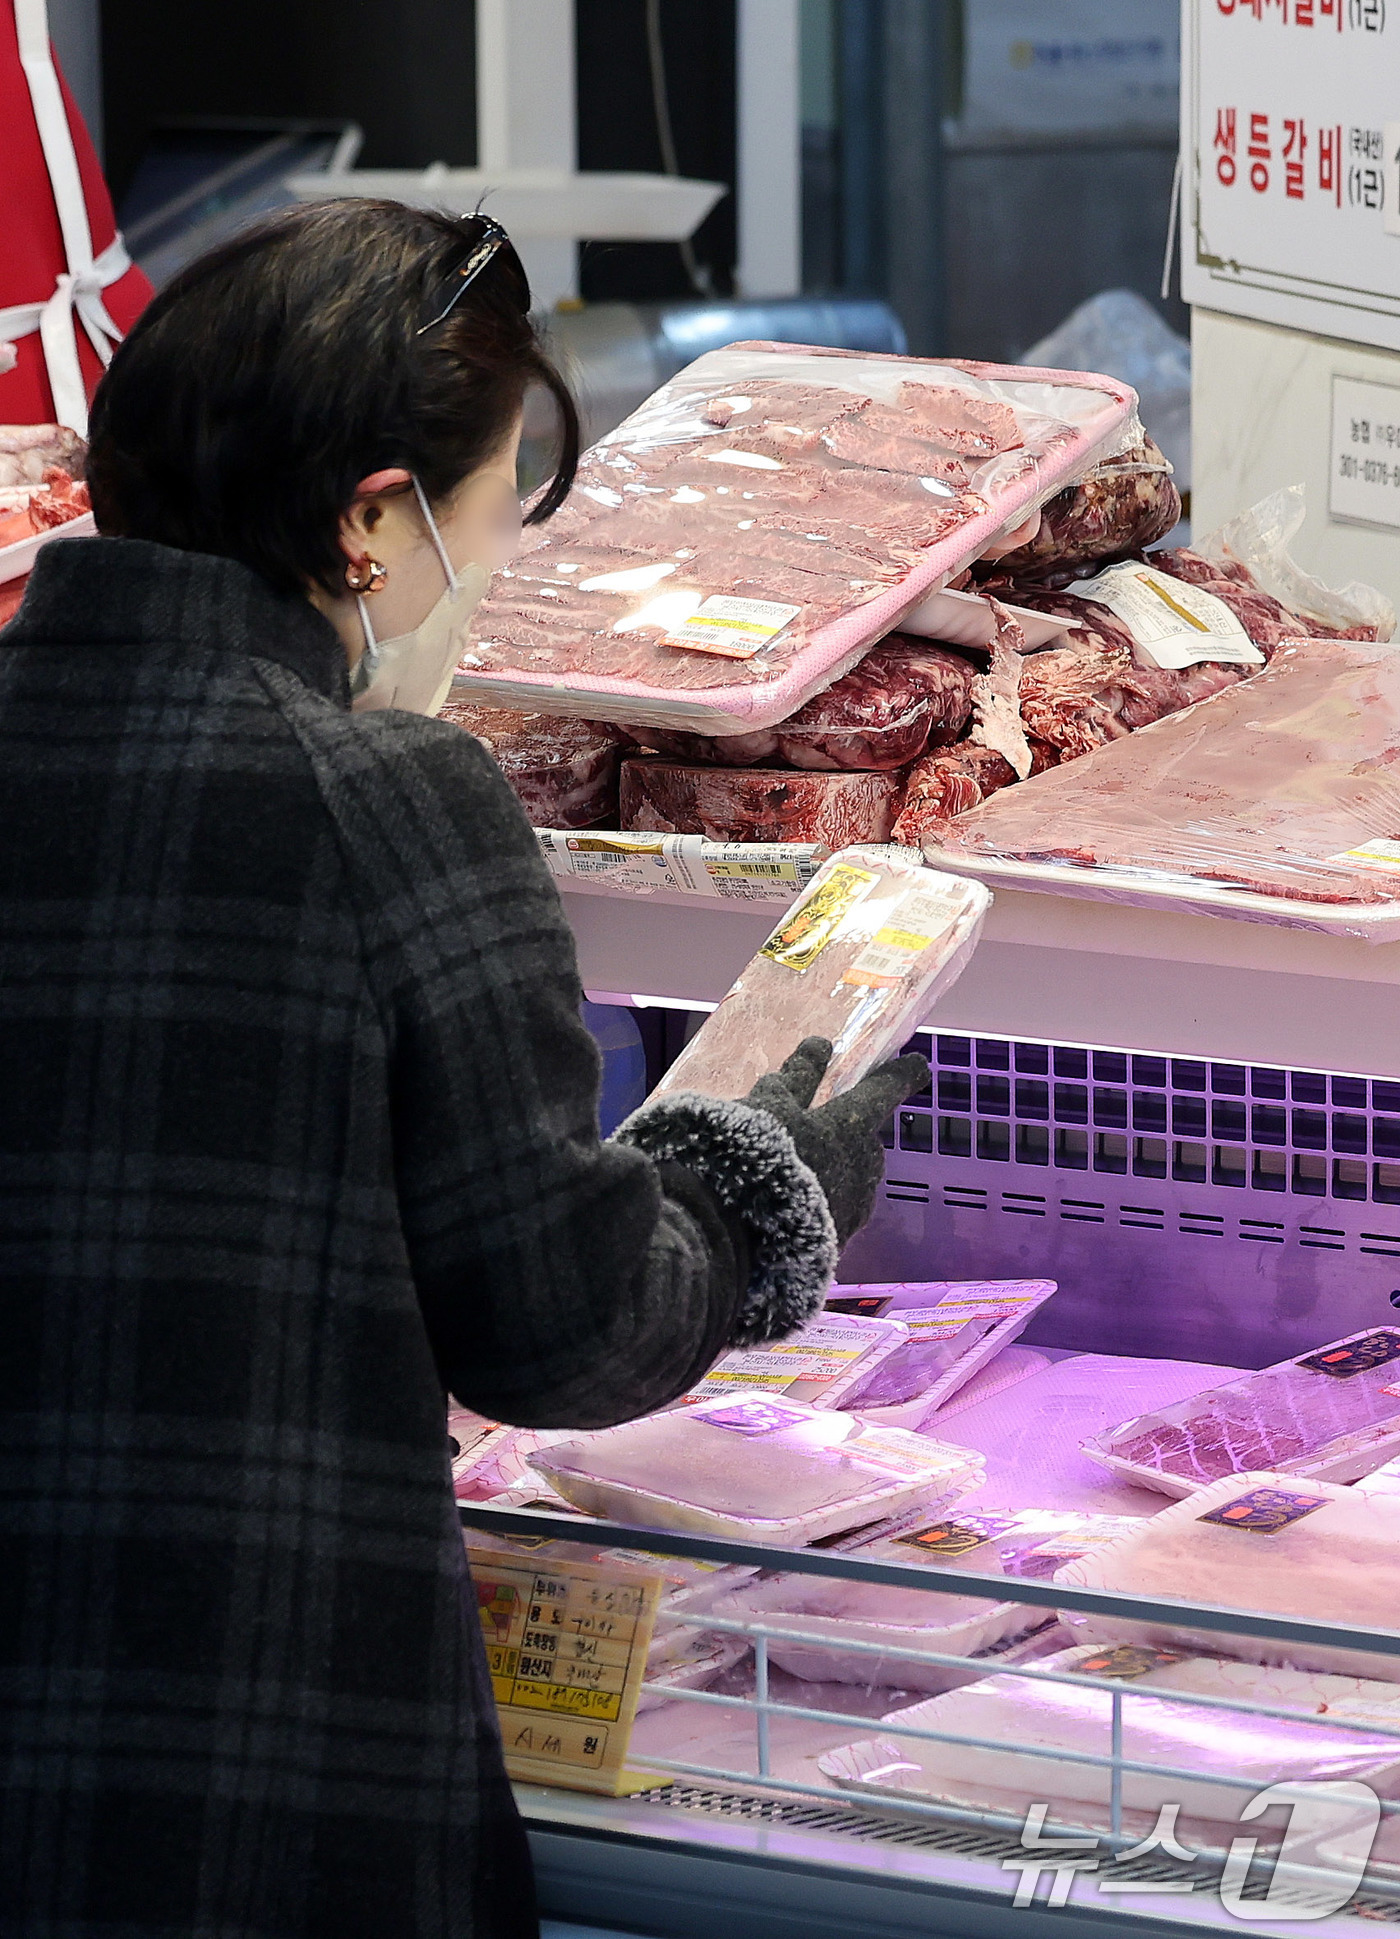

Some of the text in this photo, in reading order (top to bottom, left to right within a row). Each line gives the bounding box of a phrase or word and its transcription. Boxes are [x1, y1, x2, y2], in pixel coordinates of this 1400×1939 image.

[1213, 107, 1342, 208] 생등갈비
[520, 1656, 553, 1678] 원산지
[583, 1736, 599, 1755] 원
